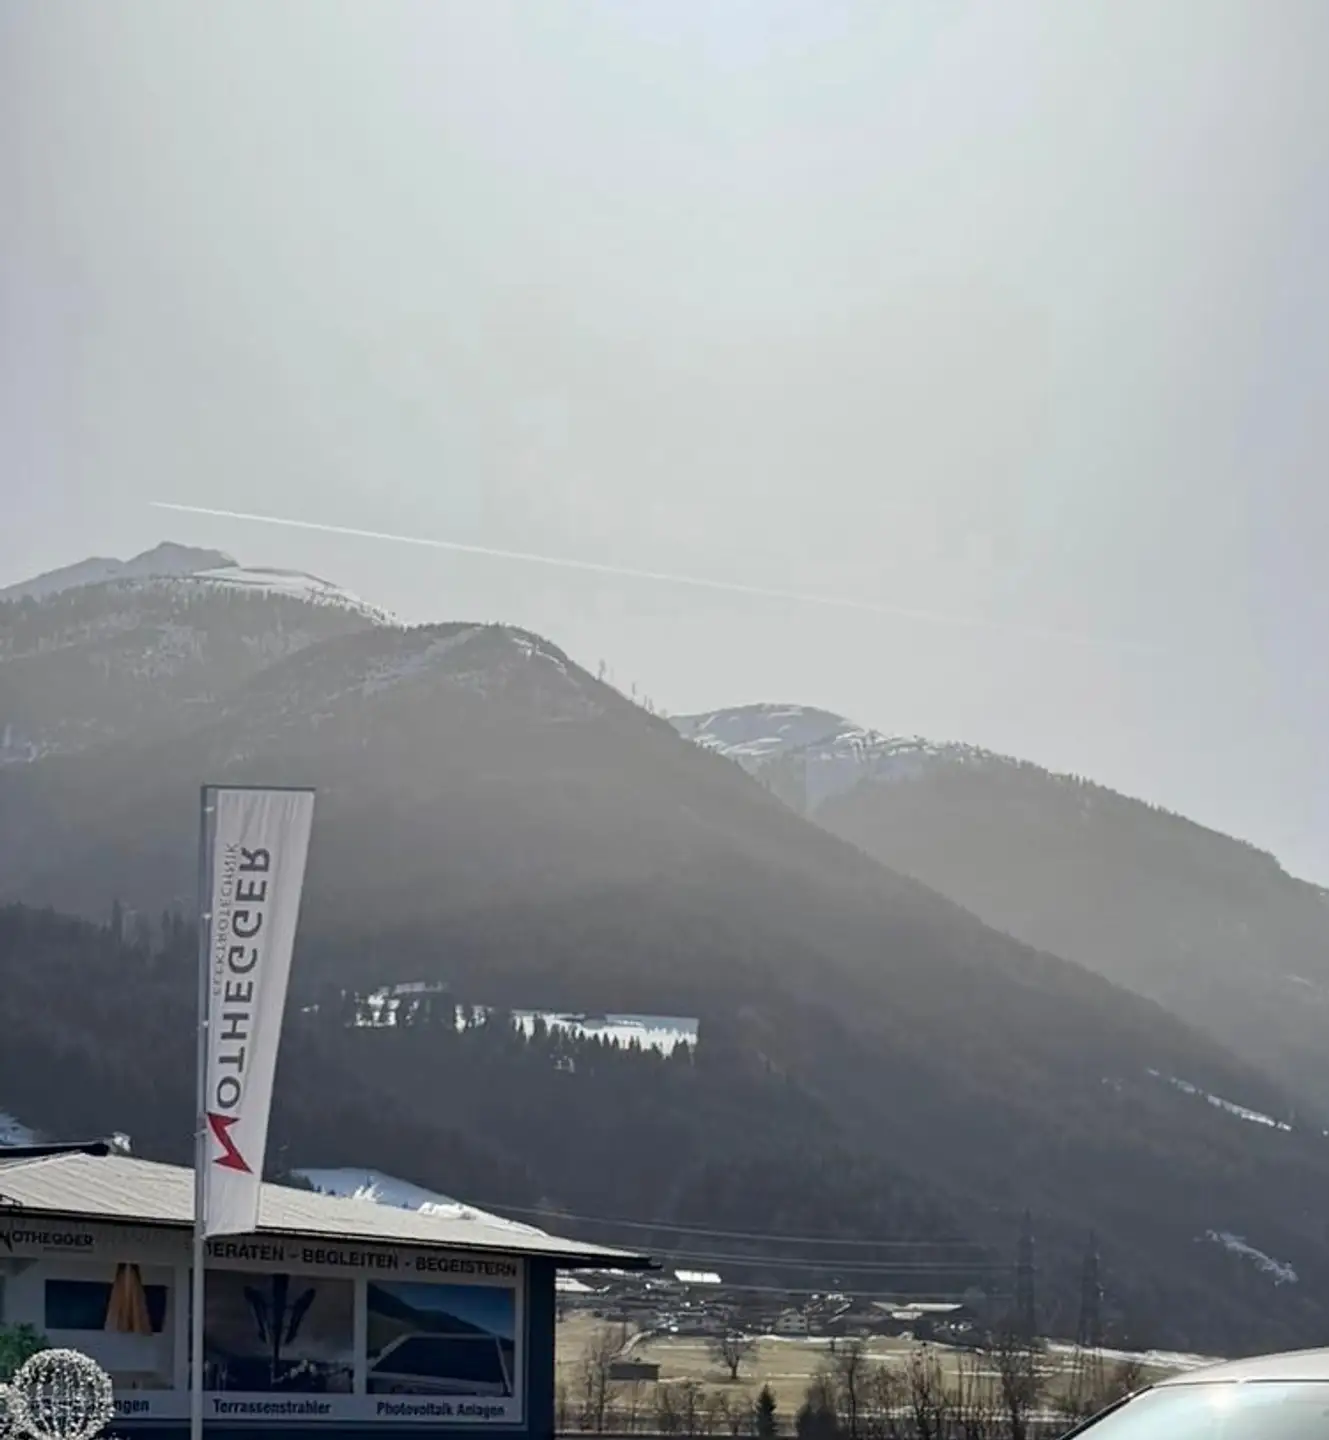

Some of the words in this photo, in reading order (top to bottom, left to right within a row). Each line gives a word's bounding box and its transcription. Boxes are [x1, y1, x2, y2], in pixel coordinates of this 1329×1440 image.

[302, 1248, 398, 1270] BEGLEITEN
[415, 1255, 517, 1277] BEGEISTERN
[213, 1399, 332, 1415] Terrassenstrahler
[457, 1402, 505, 1420] Anlagen
